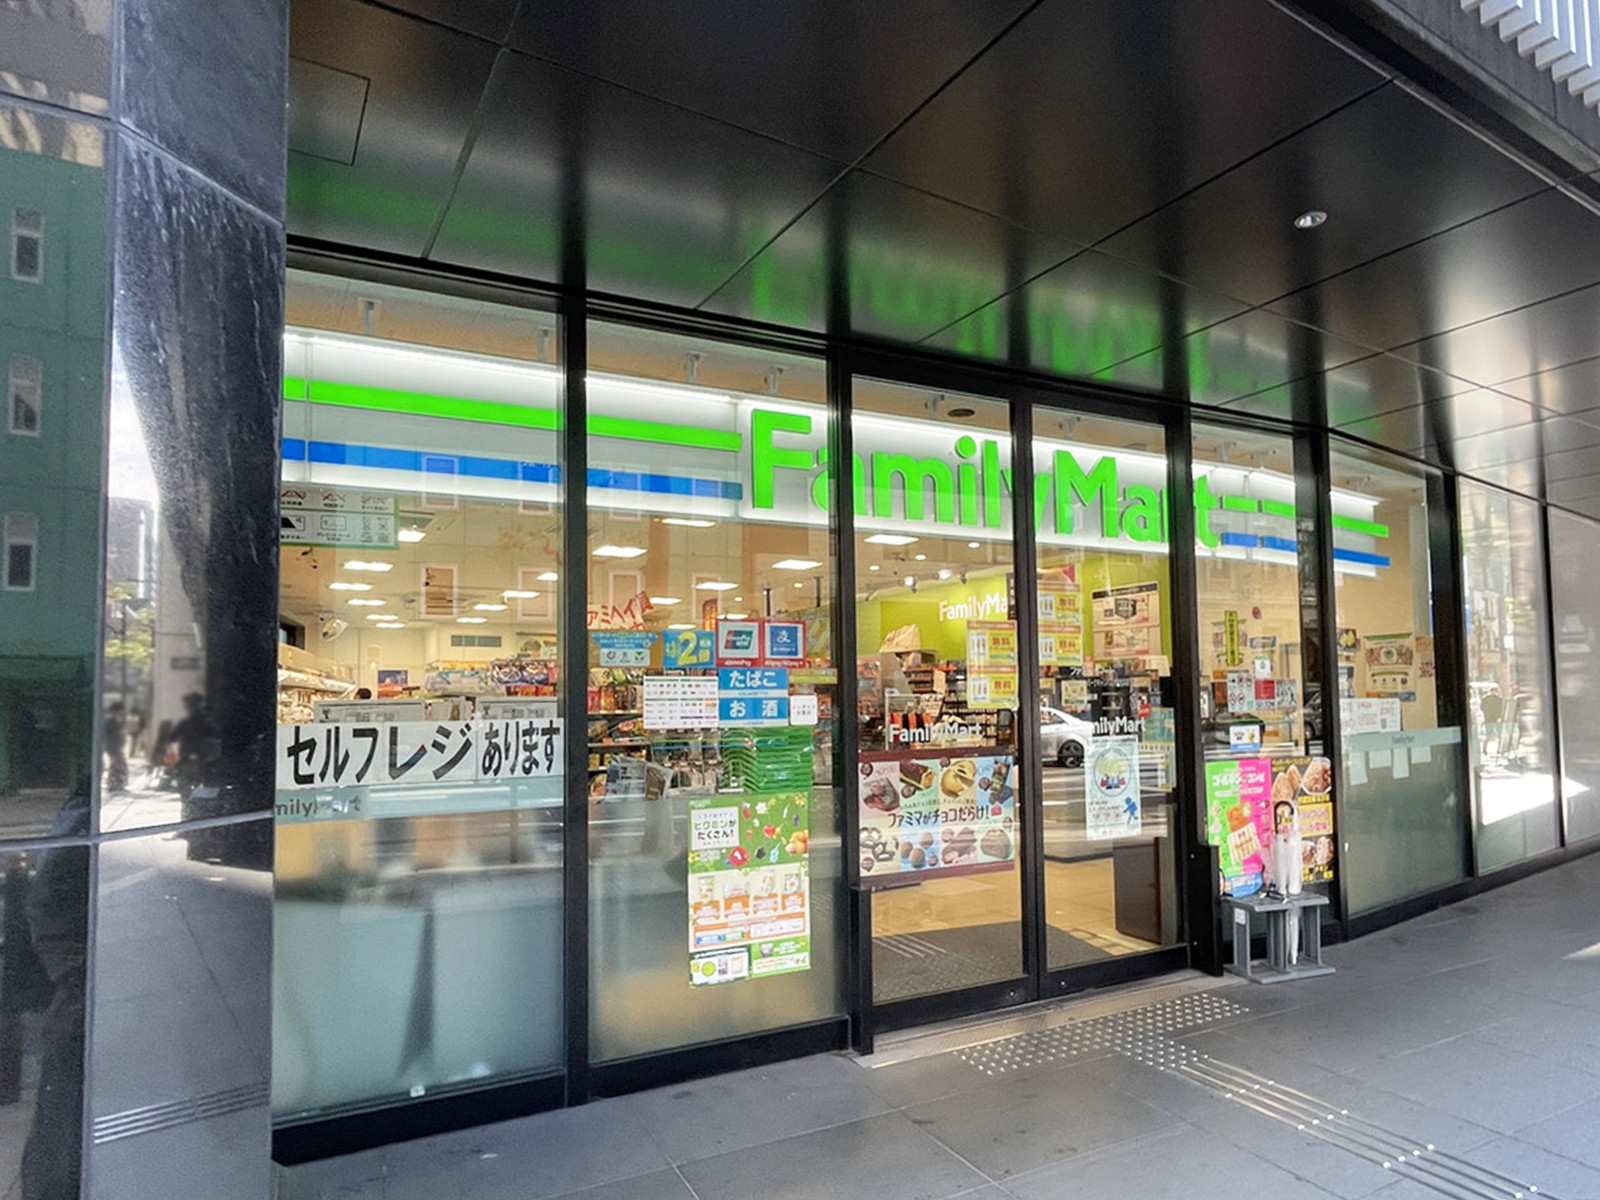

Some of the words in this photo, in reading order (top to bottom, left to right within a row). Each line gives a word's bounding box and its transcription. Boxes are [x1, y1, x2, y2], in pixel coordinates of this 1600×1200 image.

[751, 408, 1220, 549] FamilyMat
[729, 670, 778, 688] たばこ
